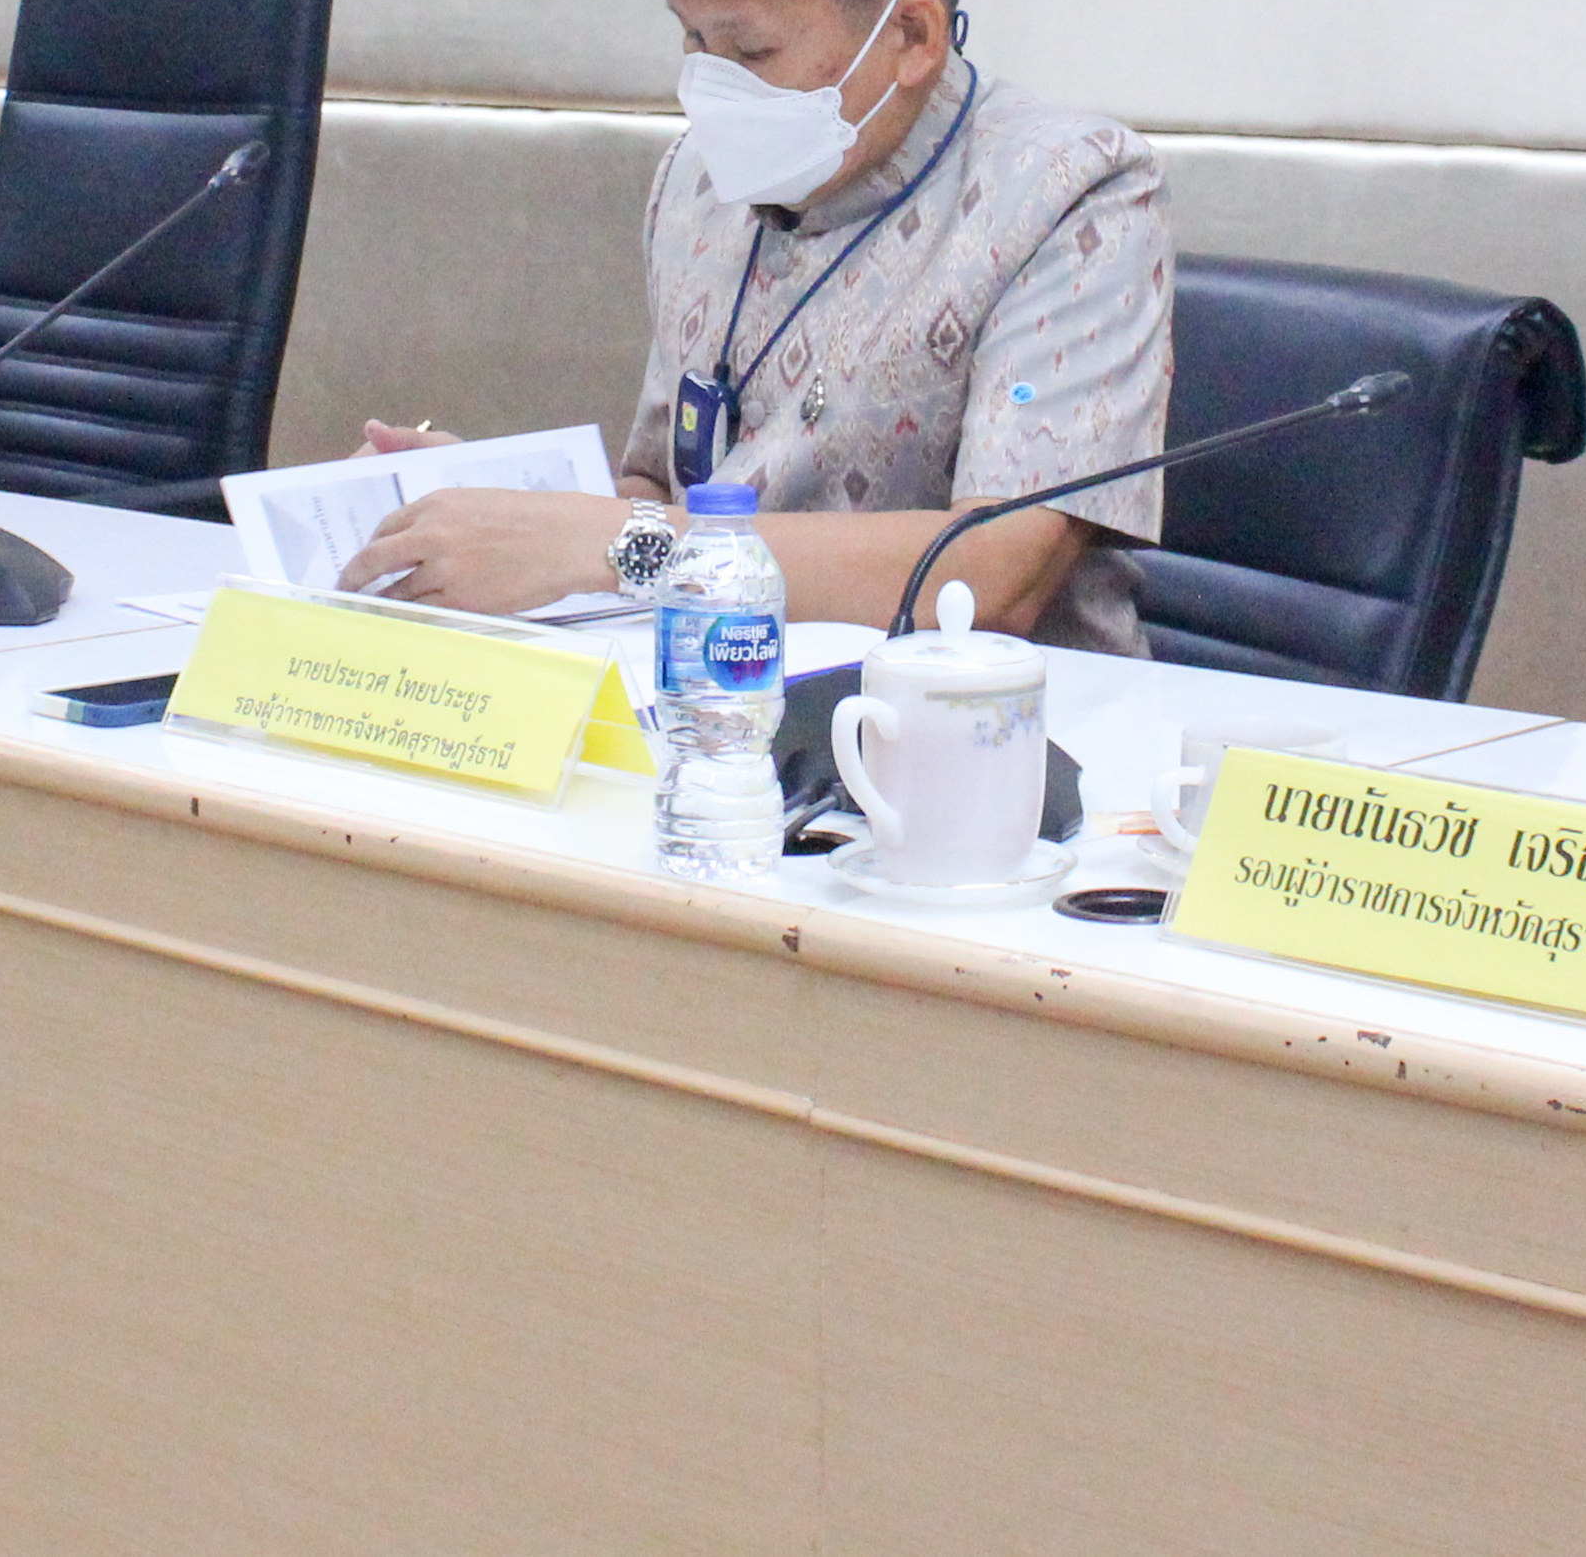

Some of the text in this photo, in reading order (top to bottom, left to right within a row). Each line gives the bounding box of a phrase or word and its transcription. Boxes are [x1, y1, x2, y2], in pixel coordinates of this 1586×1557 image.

[287, 656, 491, 722] นายประเวศ ไทยประยูร
[1264, 783, 1480, 858] นายนันธวัช
